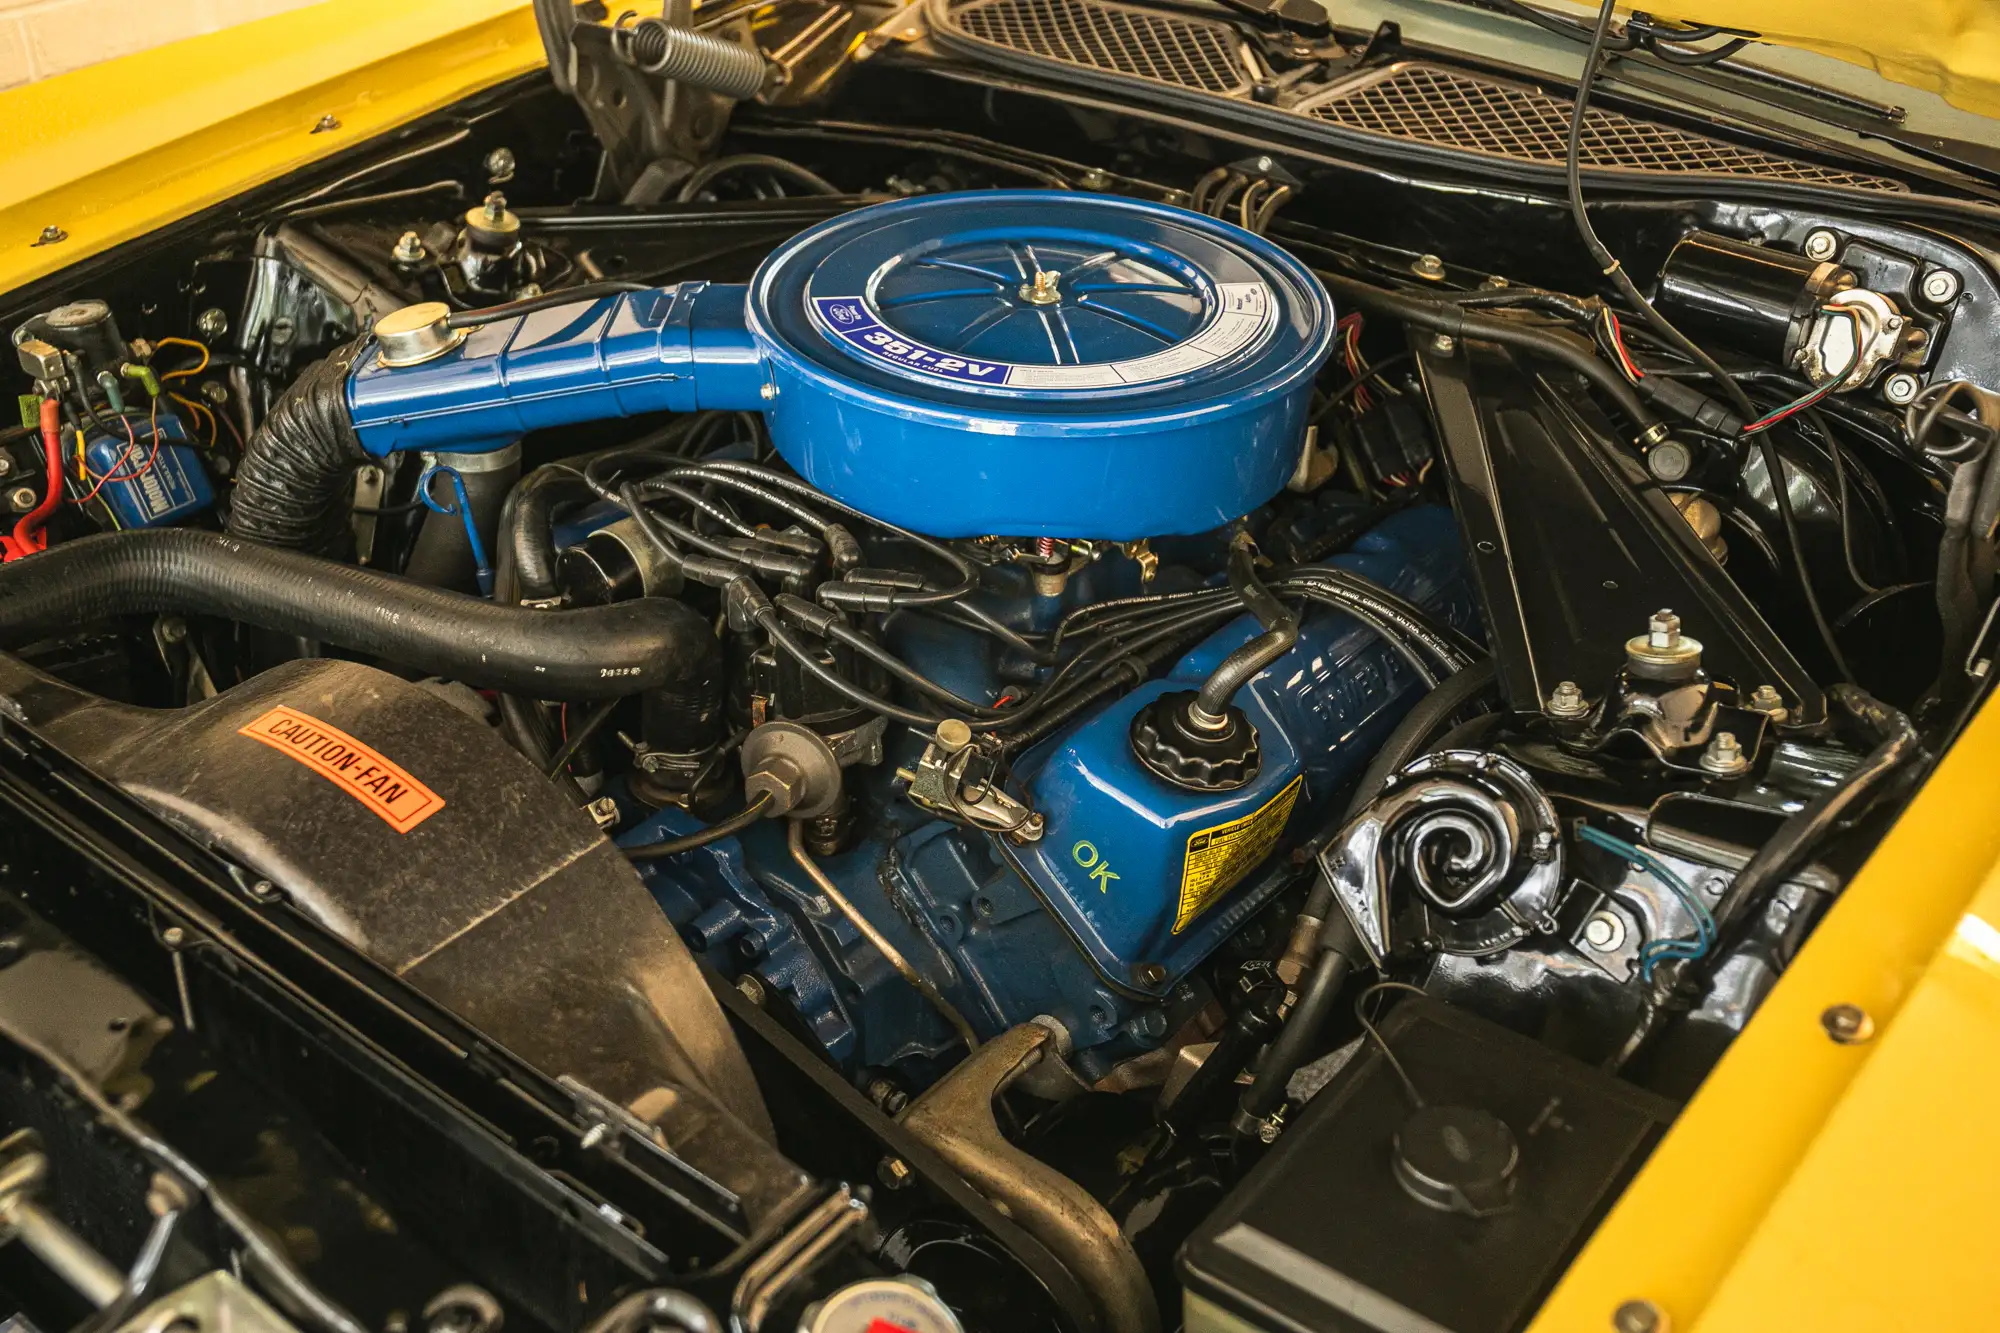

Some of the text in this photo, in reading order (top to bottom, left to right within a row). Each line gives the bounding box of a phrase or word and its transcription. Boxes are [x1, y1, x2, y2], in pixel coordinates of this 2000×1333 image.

[864, 331, 996, 376] 351-2V
[882, 351, 943, 373] REGULAR FUEL
[711, 473, 734, 484] CORE
[735, 523, 755, 538] CORE
[1306, 580, 1342, 594] EXTREME
[1362, 597, 1395, 617] CERAMIC
[1396, 615, 1420, 634] ULTRA
[268, 719, 408, 804] CAUTION-FAN
[1073, 840, 1120, 894] OK
